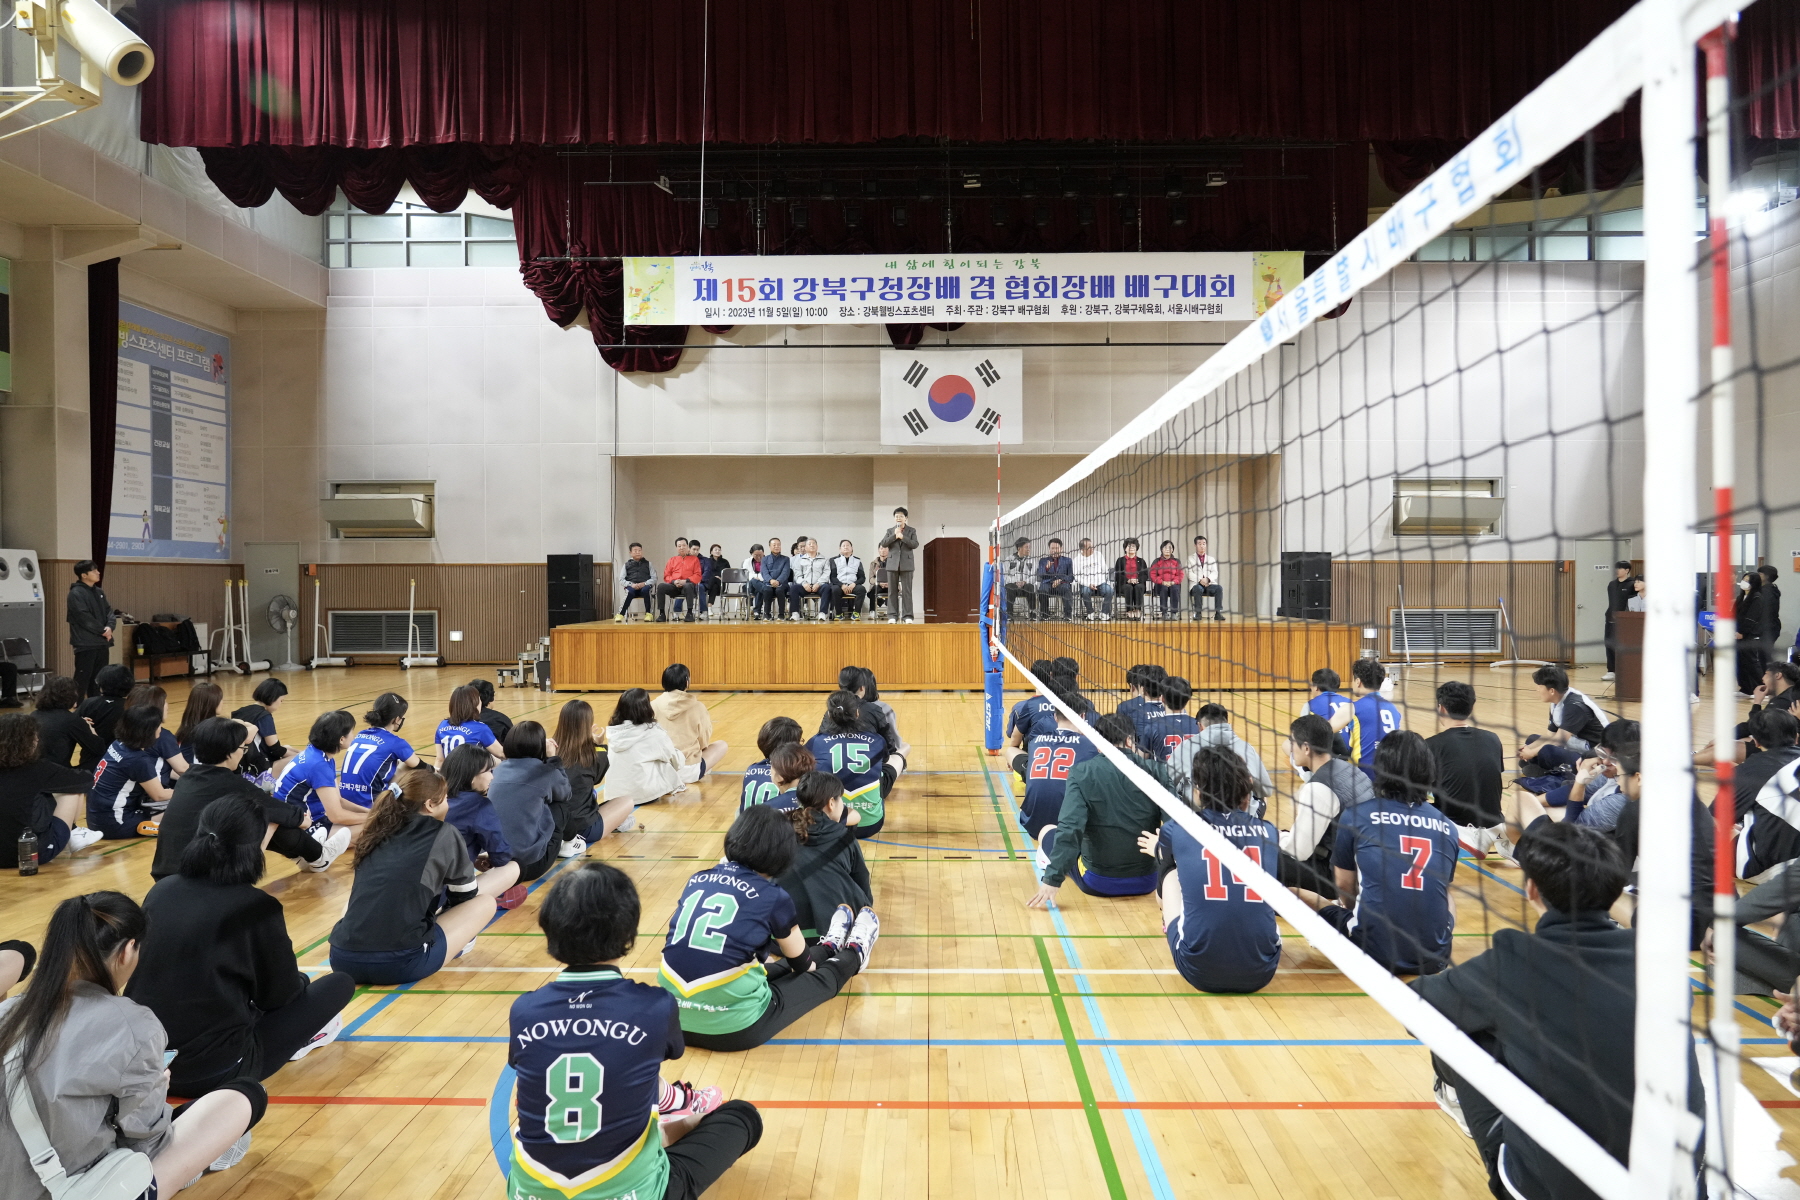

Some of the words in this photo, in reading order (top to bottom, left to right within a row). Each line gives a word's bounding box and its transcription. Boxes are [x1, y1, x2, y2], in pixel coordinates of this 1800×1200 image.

[884, 260, 897, 269] 내
[905, 259, 935, 270] 삶에
[1012, 258, 1041, 270] 강북
[692, 277, 784, 302] 제15회
[792, 276, 960, 301] 강북구청장배
[969, 275, 995, 300] 겸
[1004, 275, 1115, 300] 협회장배
[1124, 274, 1235, 298] 배구대회
[704, 307, 720, 318] 일시
[728, 307, 755, 318] 2023년
[758, 306, 774, 317] 11월
[776, 306, 803, 318] 5일(일)
[805, 306, 828, 317] 10:00
[838, 306, 855, 317] 장소
[863, 305, 935, 317] 강북웰빙스포츠센터
[991, 304, 1016, 316] 강북구
[1017, 304, 1050, 316] 배구협회
[1060, 304, 1077, 316] 후원
[1085, 304, 1112, 316] 강북구,
[1114, 303, 1165, 315] 강북구체육회,
[1167, 303, 1223, 315] 서울시배구협회
[176, 348, 211, 373] 프로그램
[823, 732, 876, 745] NOWONGU
[342, 742, 379, 775] 17
[829, 742, 871, 775] 15
[1029, 746, 1076, 780] 22
[1369, 811, 1451, 836] SEOYOUNG
[1399, 834, 1433, 892] 7
[687, 873, 760, 900] NOWONGU
[669, 889, 740, 955] 12
[516, 1017, 648, 1050] NOWONGU
[544, 1052, 605, 1144] 8
